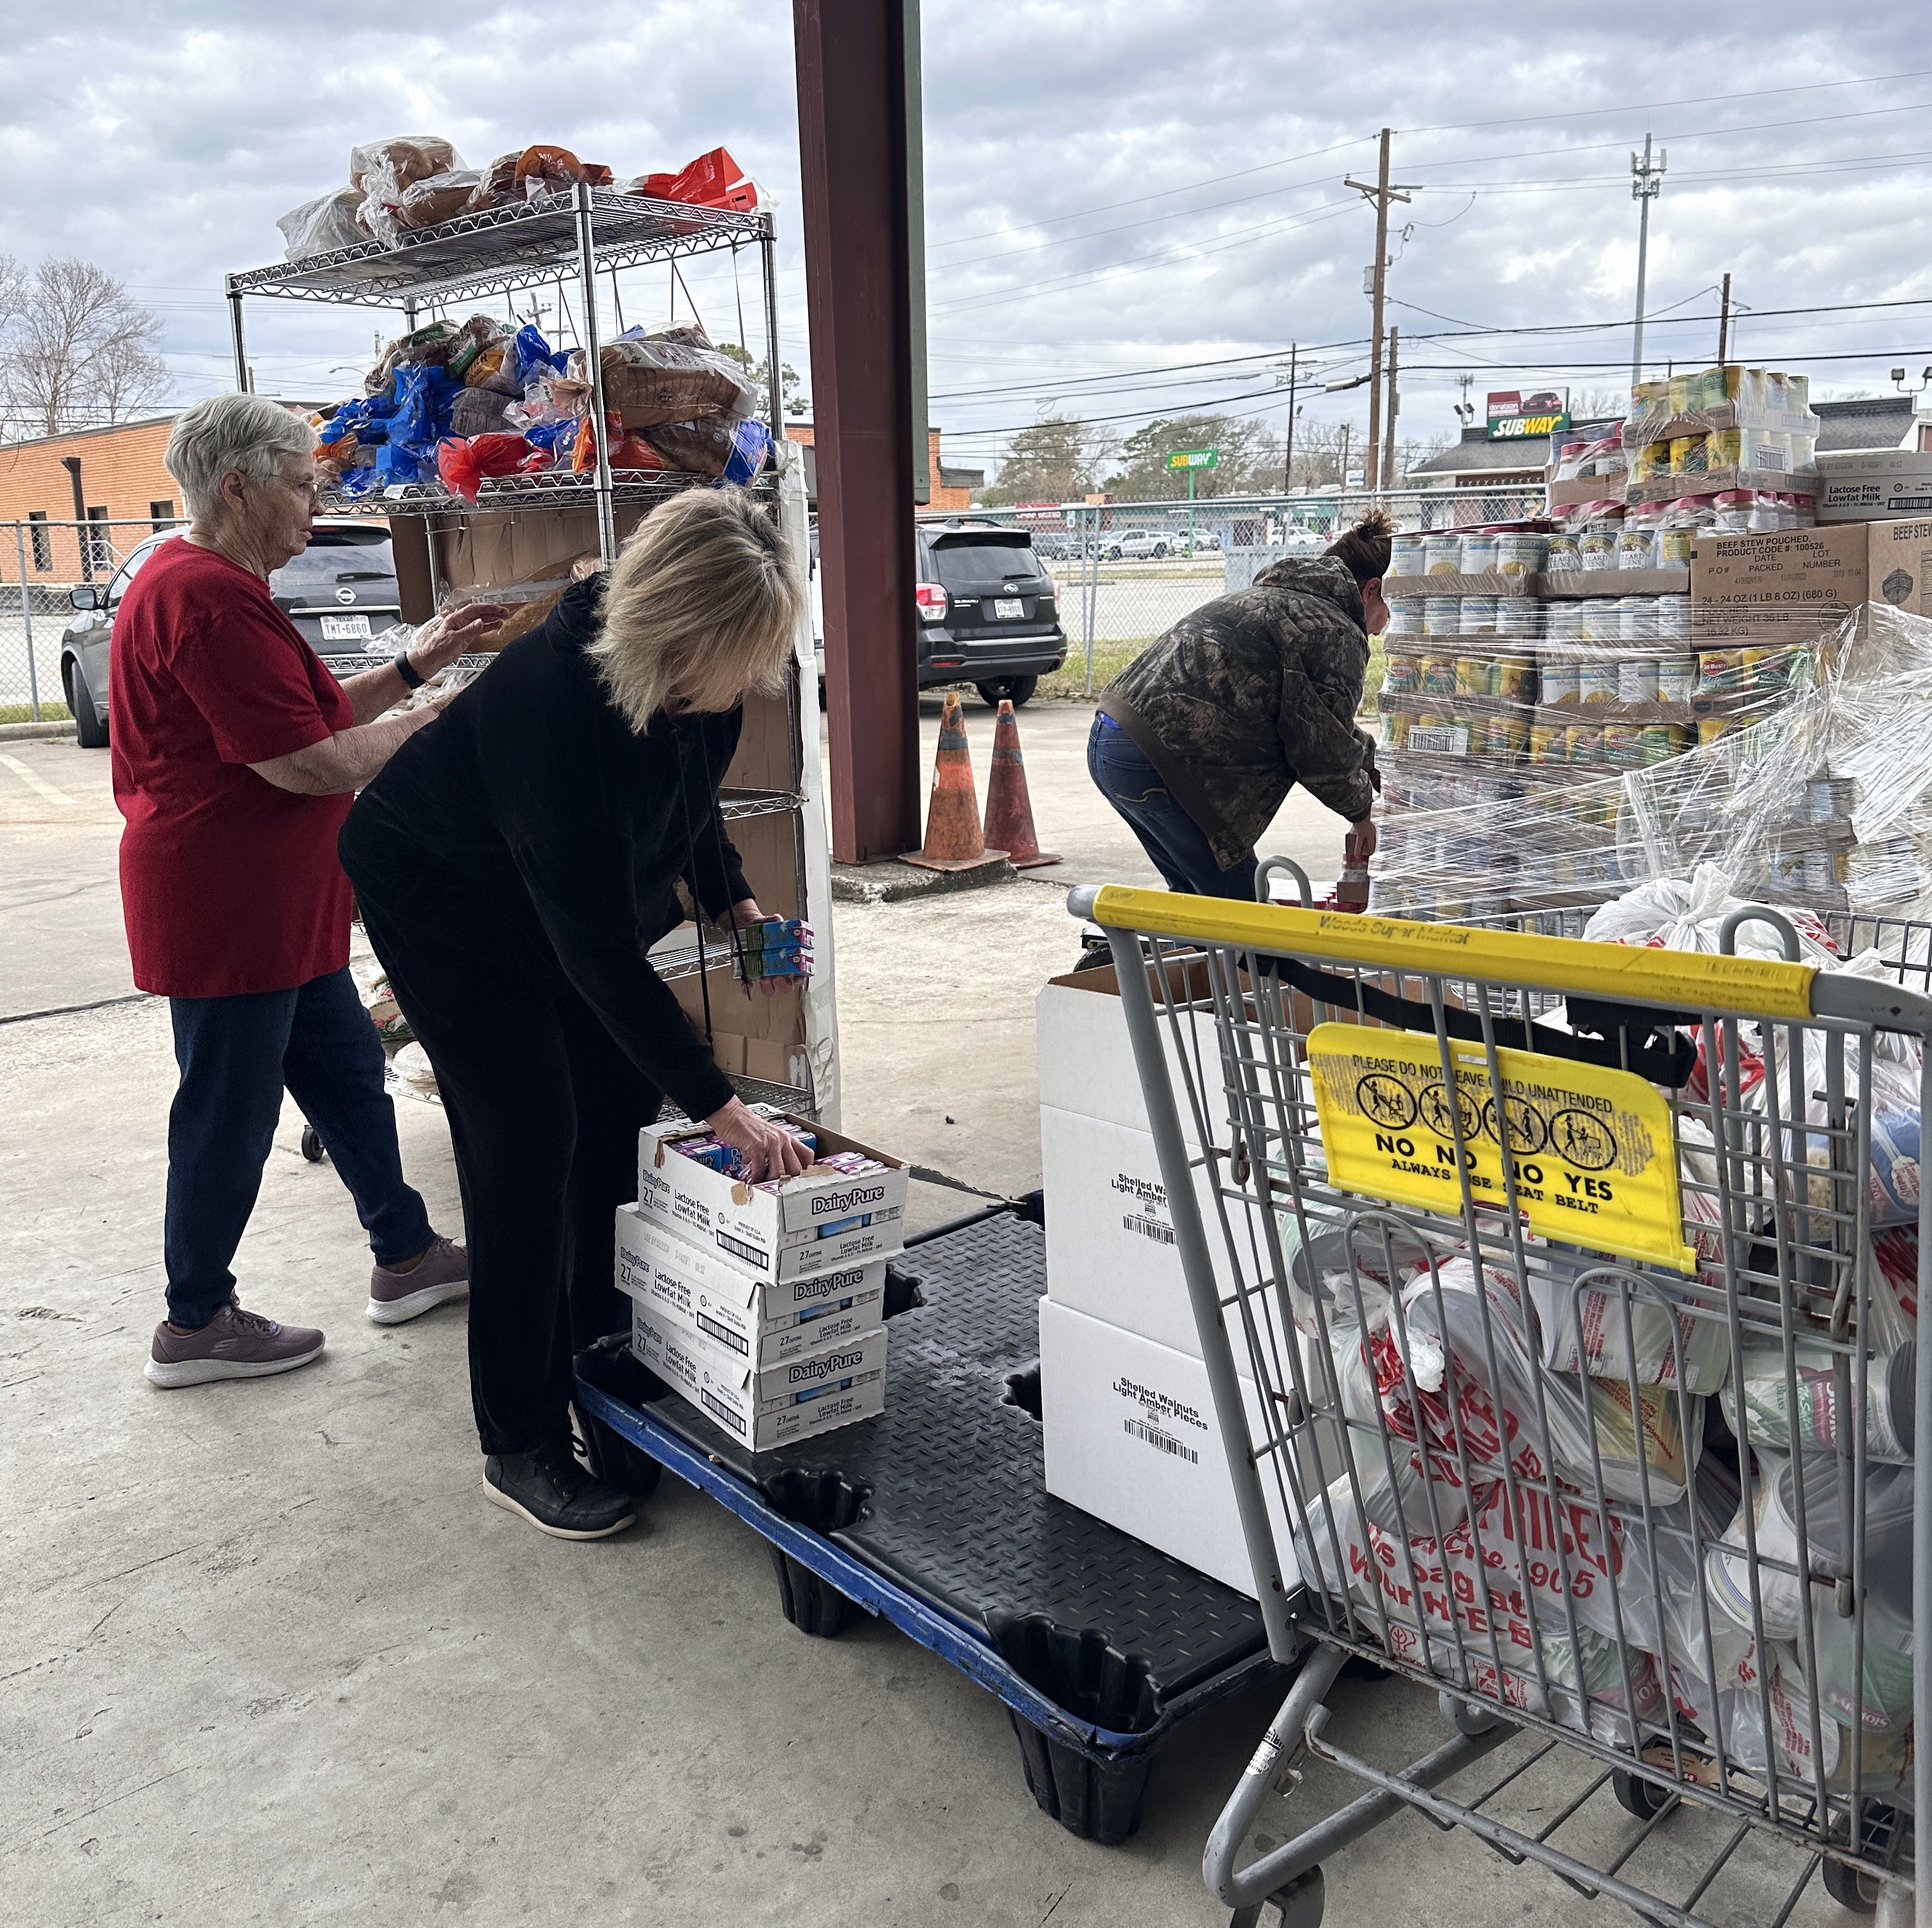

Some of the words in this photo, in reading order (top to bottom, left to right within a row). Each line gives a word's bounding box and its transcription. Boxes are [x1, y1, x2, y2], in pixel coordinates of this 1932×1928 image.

[1492, 415, 1563, 437] SUBWAY
[1170, 452, 1211, 468] SUBWAY
[1828, 494, 1859, 502] Lowfat
[1862, 493, 1880, 501] Milk
[1894, 525, 1913, 541] BEEF
[1717, 548, 1756, 557] PRODUCT
[1795, 543, 1824, 551] 100526
[1749, 563, 1783, 573] PACKED
[1803, 559, 1841, 569] NUMBER
[1734, 594, 1746, 603] OZ
[1760, 593, 1772, 601] LB
[1783, 590, 1800, 601] OZ)
[1802, 589, 1823, 601] (680
[1825, 589, 1837, 599] G)
[1353, 1054, 1397, 1073] PLEASE
[1399, 1061, 1416, 1076] DO
[1420, 1064, 1443, 1080] NOT
[1455, 1070, 1485, 1087] EAVE
[1528, 1083, 1613, 1113] UNATTENDED
[1375, 1133, 1415, 1157] NO
[1436, 1145, 1477, 1169] NO
[1563, 1171, 1613, 1201] YES
[643, 1169, 670, 1194] DairyPure
[1119, 1173, 1151, 1191] Shelled
[1392, 1159, 1451, 1180] ALWAYS
[1554, 1194, 1598, 1214] BELT
[643, 1187, 654, 1205] 27
[1112, 1179, 1134, 1194] Light
[1137, 1187, 1167, 1203] Amber
[675, 1189, 696, 1208] Lactose
[696, 1201, 710, 1215] Free
[812, 1186, 884, 1215] DairyPure
[675, 1200, 696, 1219] Lowfat
[697, 1214, 710, 1228] Milk
[840, 1240, 861, 1249] Lactose
[862, 1235, 875, 1244] Free
[841, 1245, 860, 1255] Lowfat
[862, 1241, 873, 1249] Milk
[620, 1246, 650, 1272] DairyPure
[799, 1251, 809, 1261] 27
[620, 1263, 631, 1281] 27
[655, 1268, 677, 1288] Lactose
[678, 1281, 691, 1297] Free
[793, 1269, 863, 1301] DairyPure
[654, 1279, 676, 1300] Lowfat
[677, 1293, 691, 1309] Milk
[819, 1322, 839, 1333] Lactose
[820, 1327, 839, 1338] Lowfat
[638, 1334, 647, 1352] 27
[779, 1336, 789, 1346] 27
[666, 1341, 685, 1361] Lactose
[685, 1355, 696, 1373] Free
[666, 1352, 684, 1373] Lowfat
[685, 1369, 696, 1385] Milk
[789, 1351, 862, 1384] DairyPure
[1121, 1377, 1156, 1399] Shelled
[1159, 1393, 1199, 1418] Walnuts
[1798, 1385, 1809, 1401] No
[818, 1402, 839, 1413] Lactose
[841, 1397, 854, 1405] Free
[818, 1407, 839, 1417] Lowfat
[840, 1403, 852, 1411] Milk
[1113, 1382, 1137, 1400] Light
[1140, 1394, 1171, 1416] Amber
[1174, 1408, 1208, 1430] Pieces
[776, 1415, 786, 1426] 27
[1422, 1590, 1533, 1649] H-E-B
